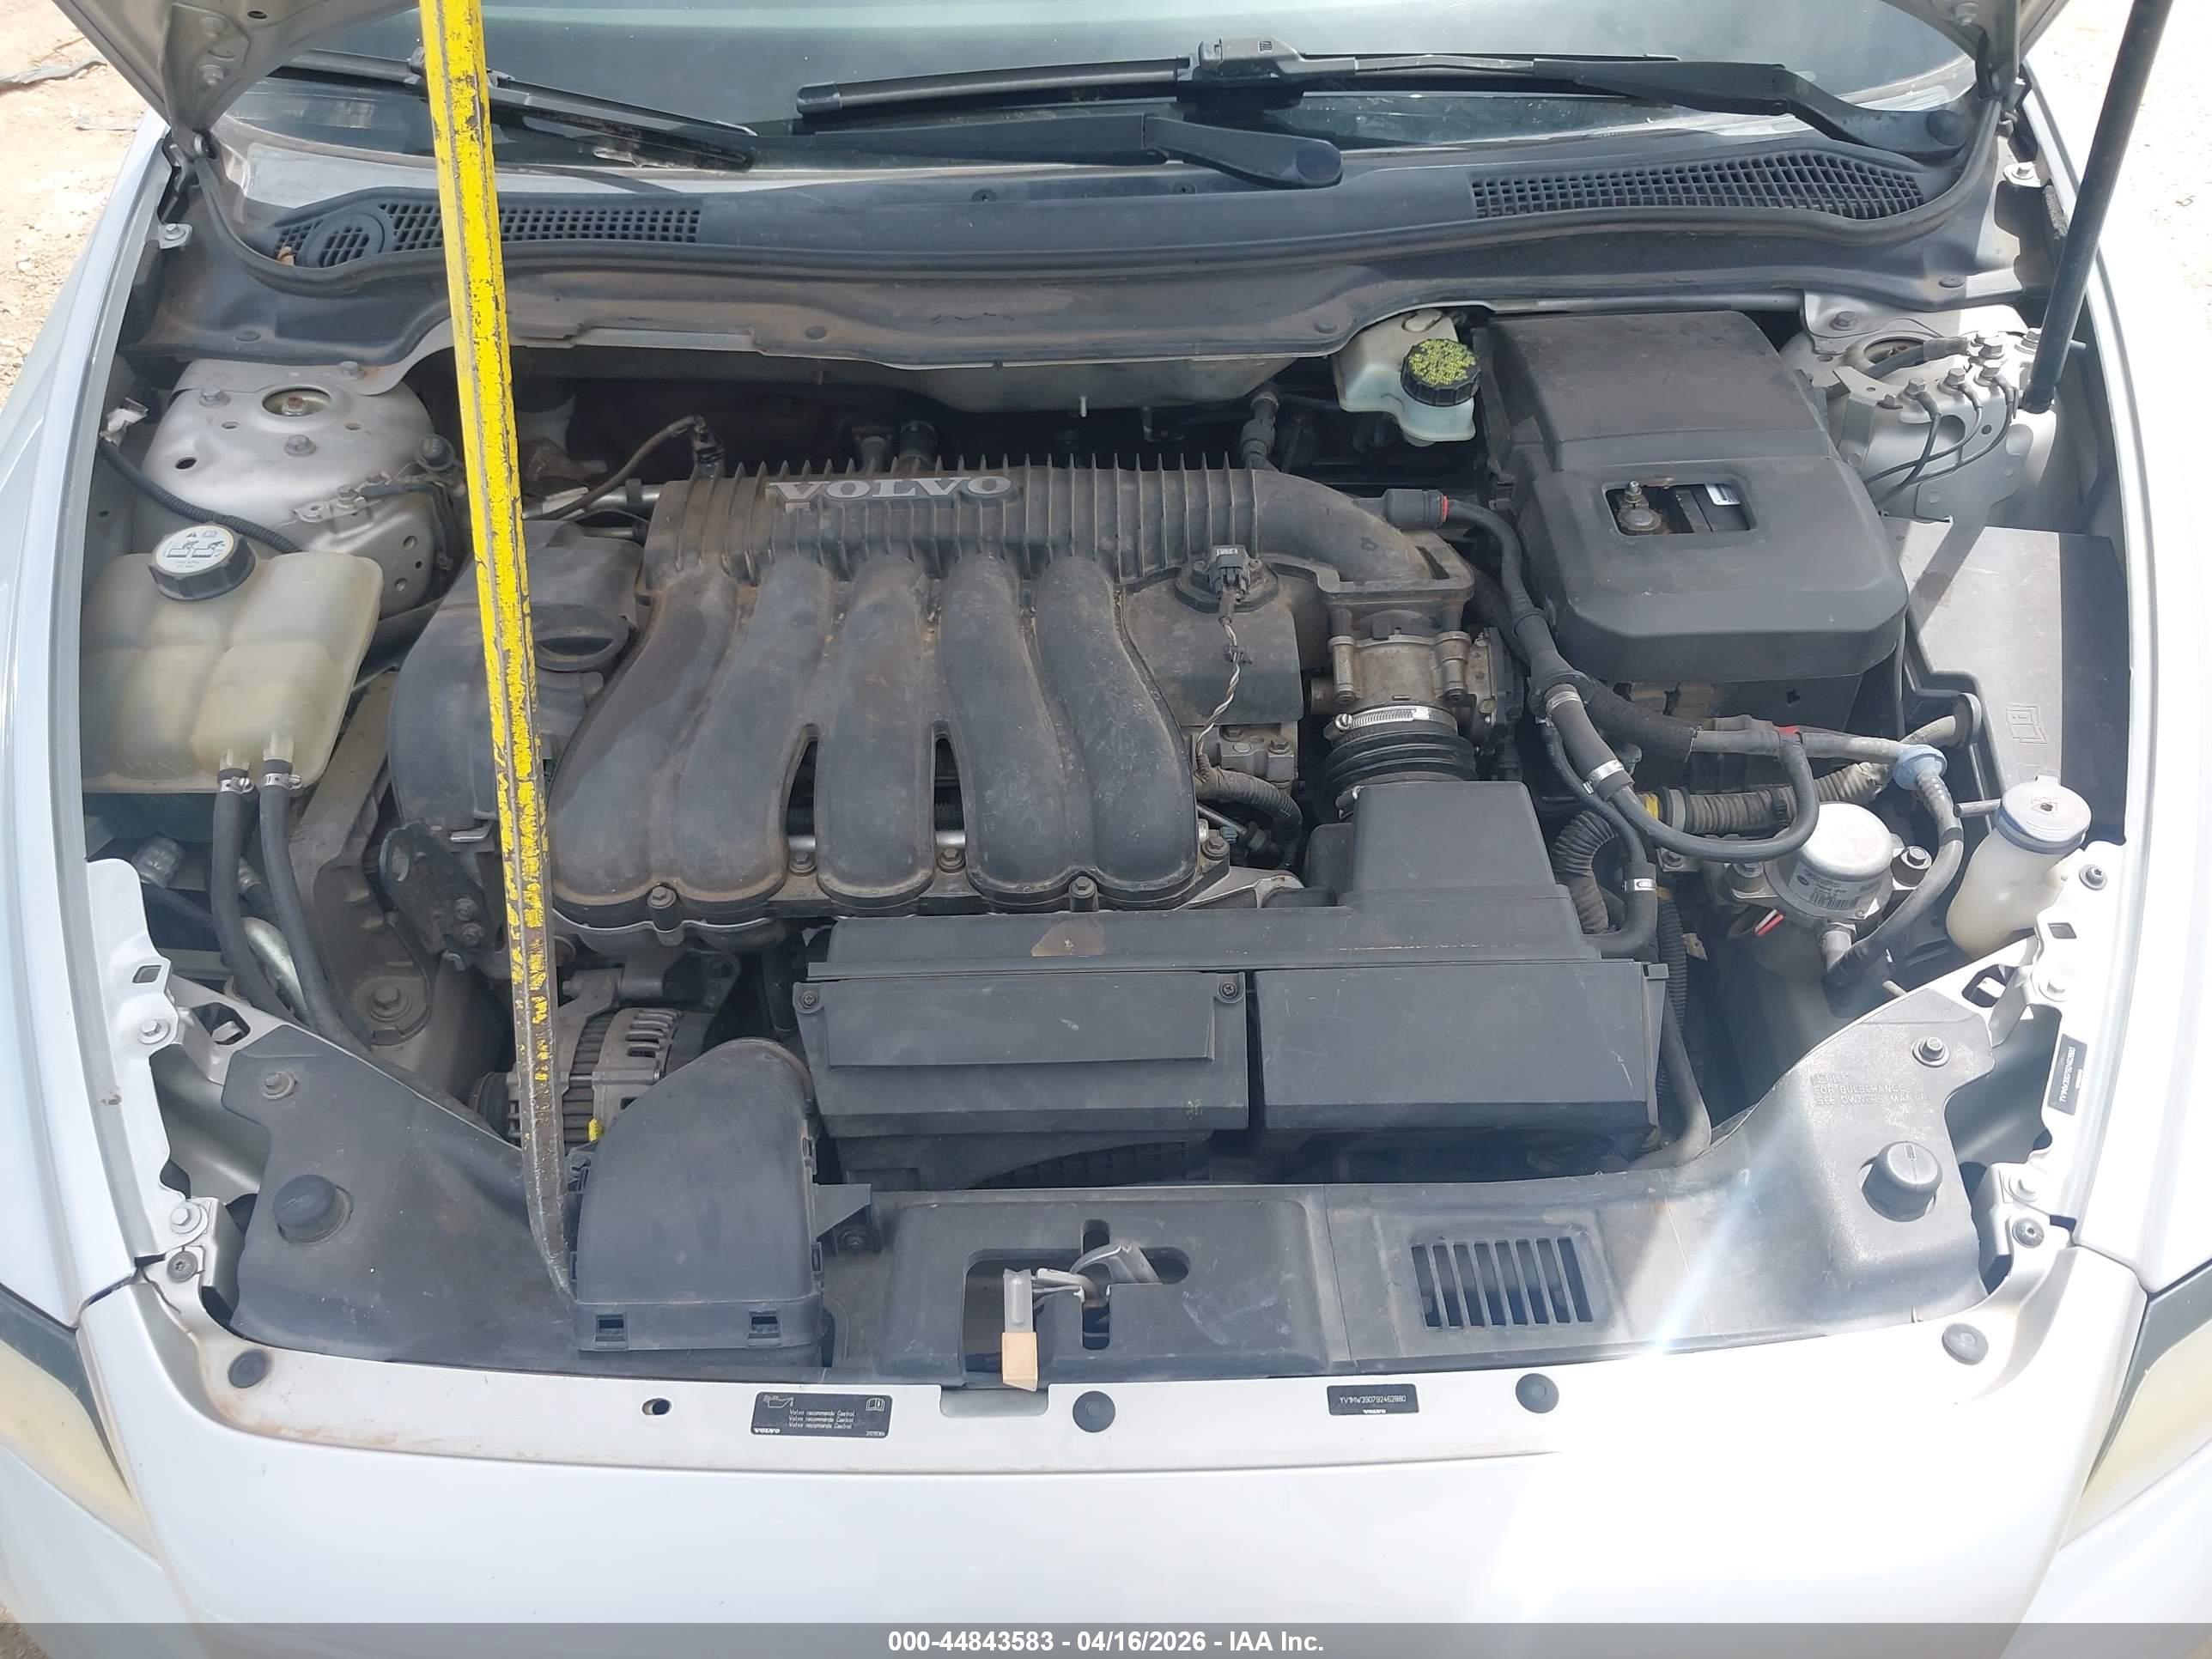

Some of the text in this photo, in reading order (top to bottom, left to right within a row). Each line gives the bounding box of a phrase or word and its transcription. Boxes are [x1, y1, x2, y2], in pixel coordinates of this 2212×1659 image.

[769, 476, 1012, 500] VOLVO
[1814, 1085, 1835, 1095] FOR
[1817, 1097, 1836, 1106] SEE
[788, 1414, 804, 1423] Volvo
